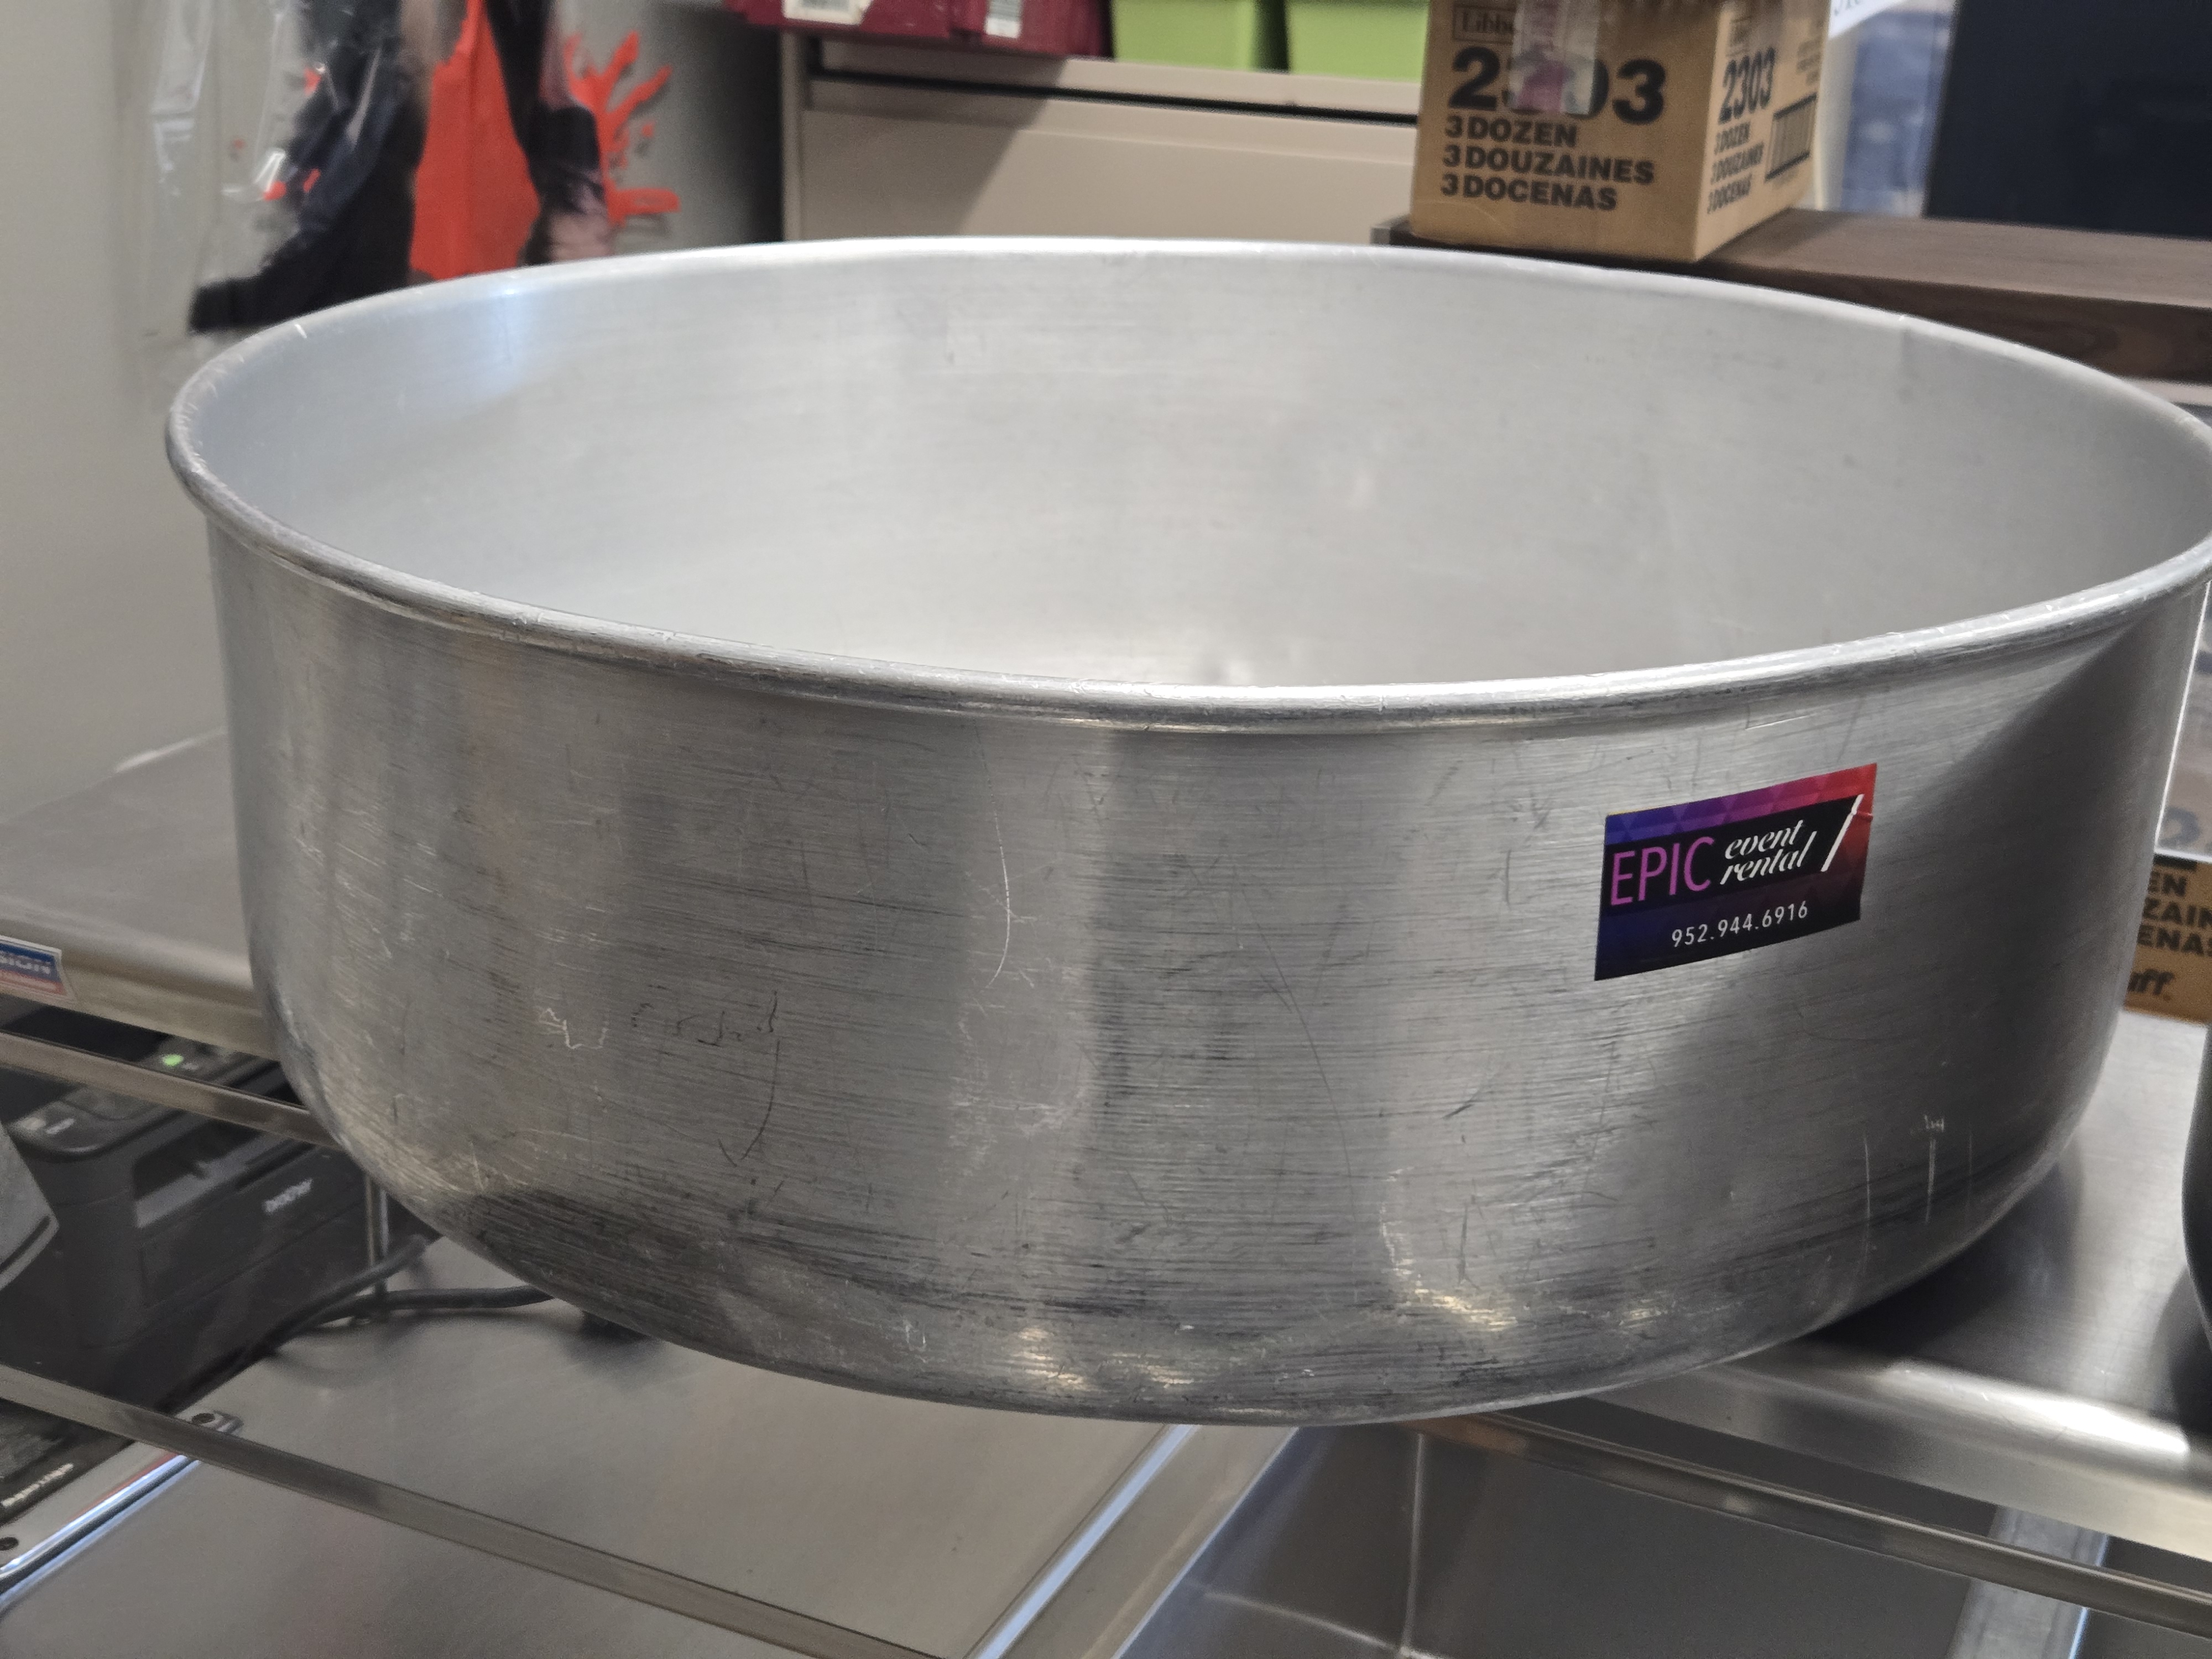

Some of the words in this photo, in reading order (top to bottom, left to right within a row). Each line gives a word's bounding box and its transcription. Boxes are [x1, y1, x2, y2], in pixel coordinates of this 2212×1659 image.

[1718, 47, 1776, 123] 2303
[1467, 116, 1578, 148] DOZEN
[1465, 145, 1655, 186] DOUZAINES
[1463, 174, 1618, 211] DOCENAS
[1720, 831, 1817, 885] rental
[1724, 820, 1804, 859] event
[1610, 836, 1714, 906] EPIC
[1672, 900, 1808, 947] 952.944.6916
